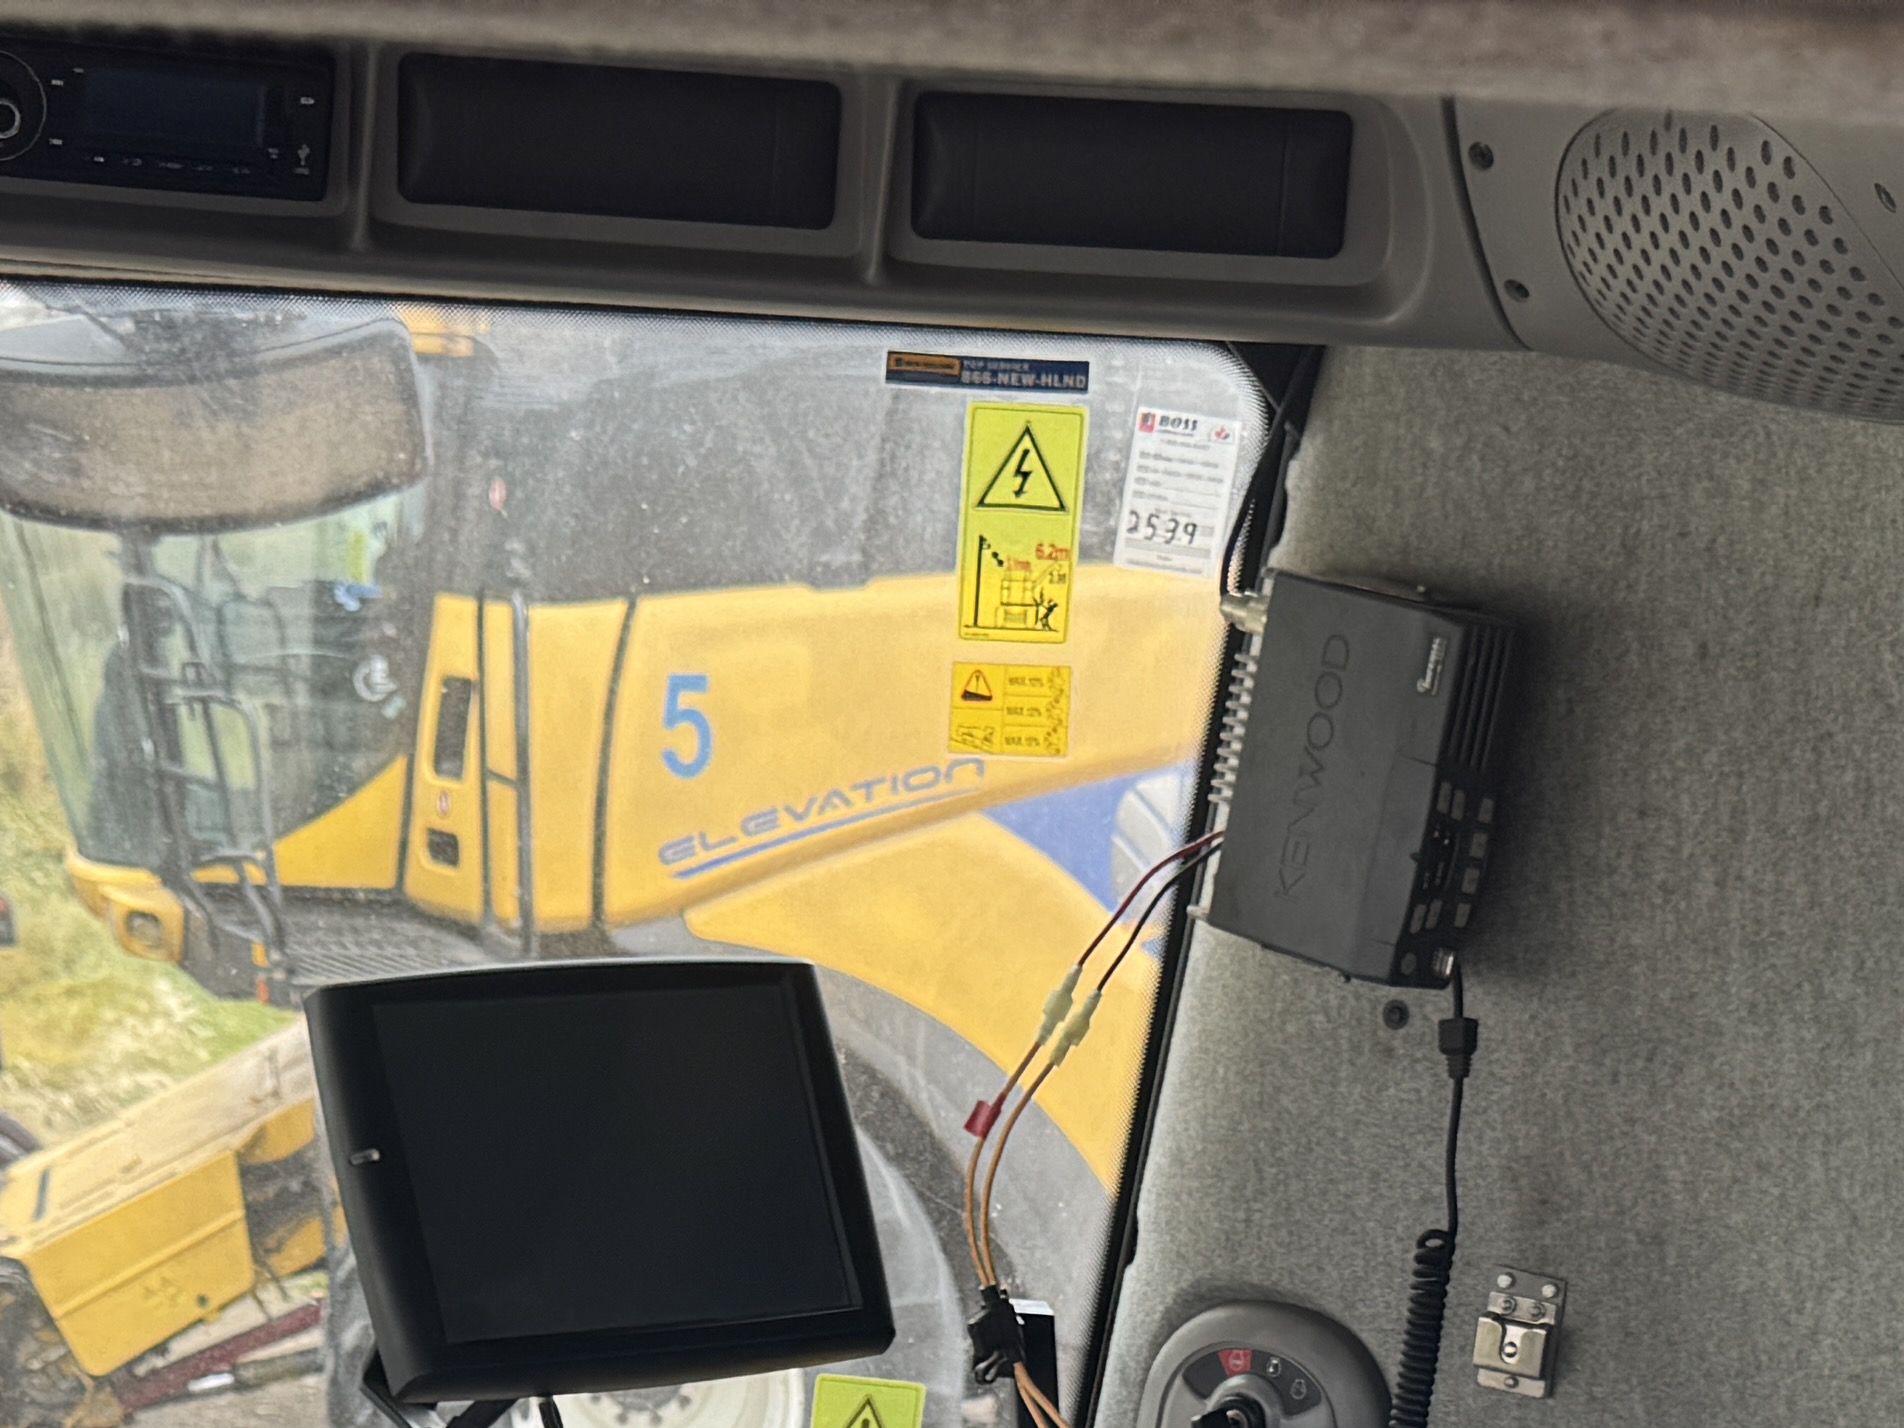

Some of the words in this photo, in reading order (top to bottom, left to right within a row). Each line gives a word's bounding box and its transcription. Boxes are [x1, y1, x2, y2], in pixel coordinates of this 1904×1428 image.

[1158, 415, 1199, 432] BOSS
[660, 674, 713, 780] 5
[1274, 633, 1350, 898] KENWOOD
